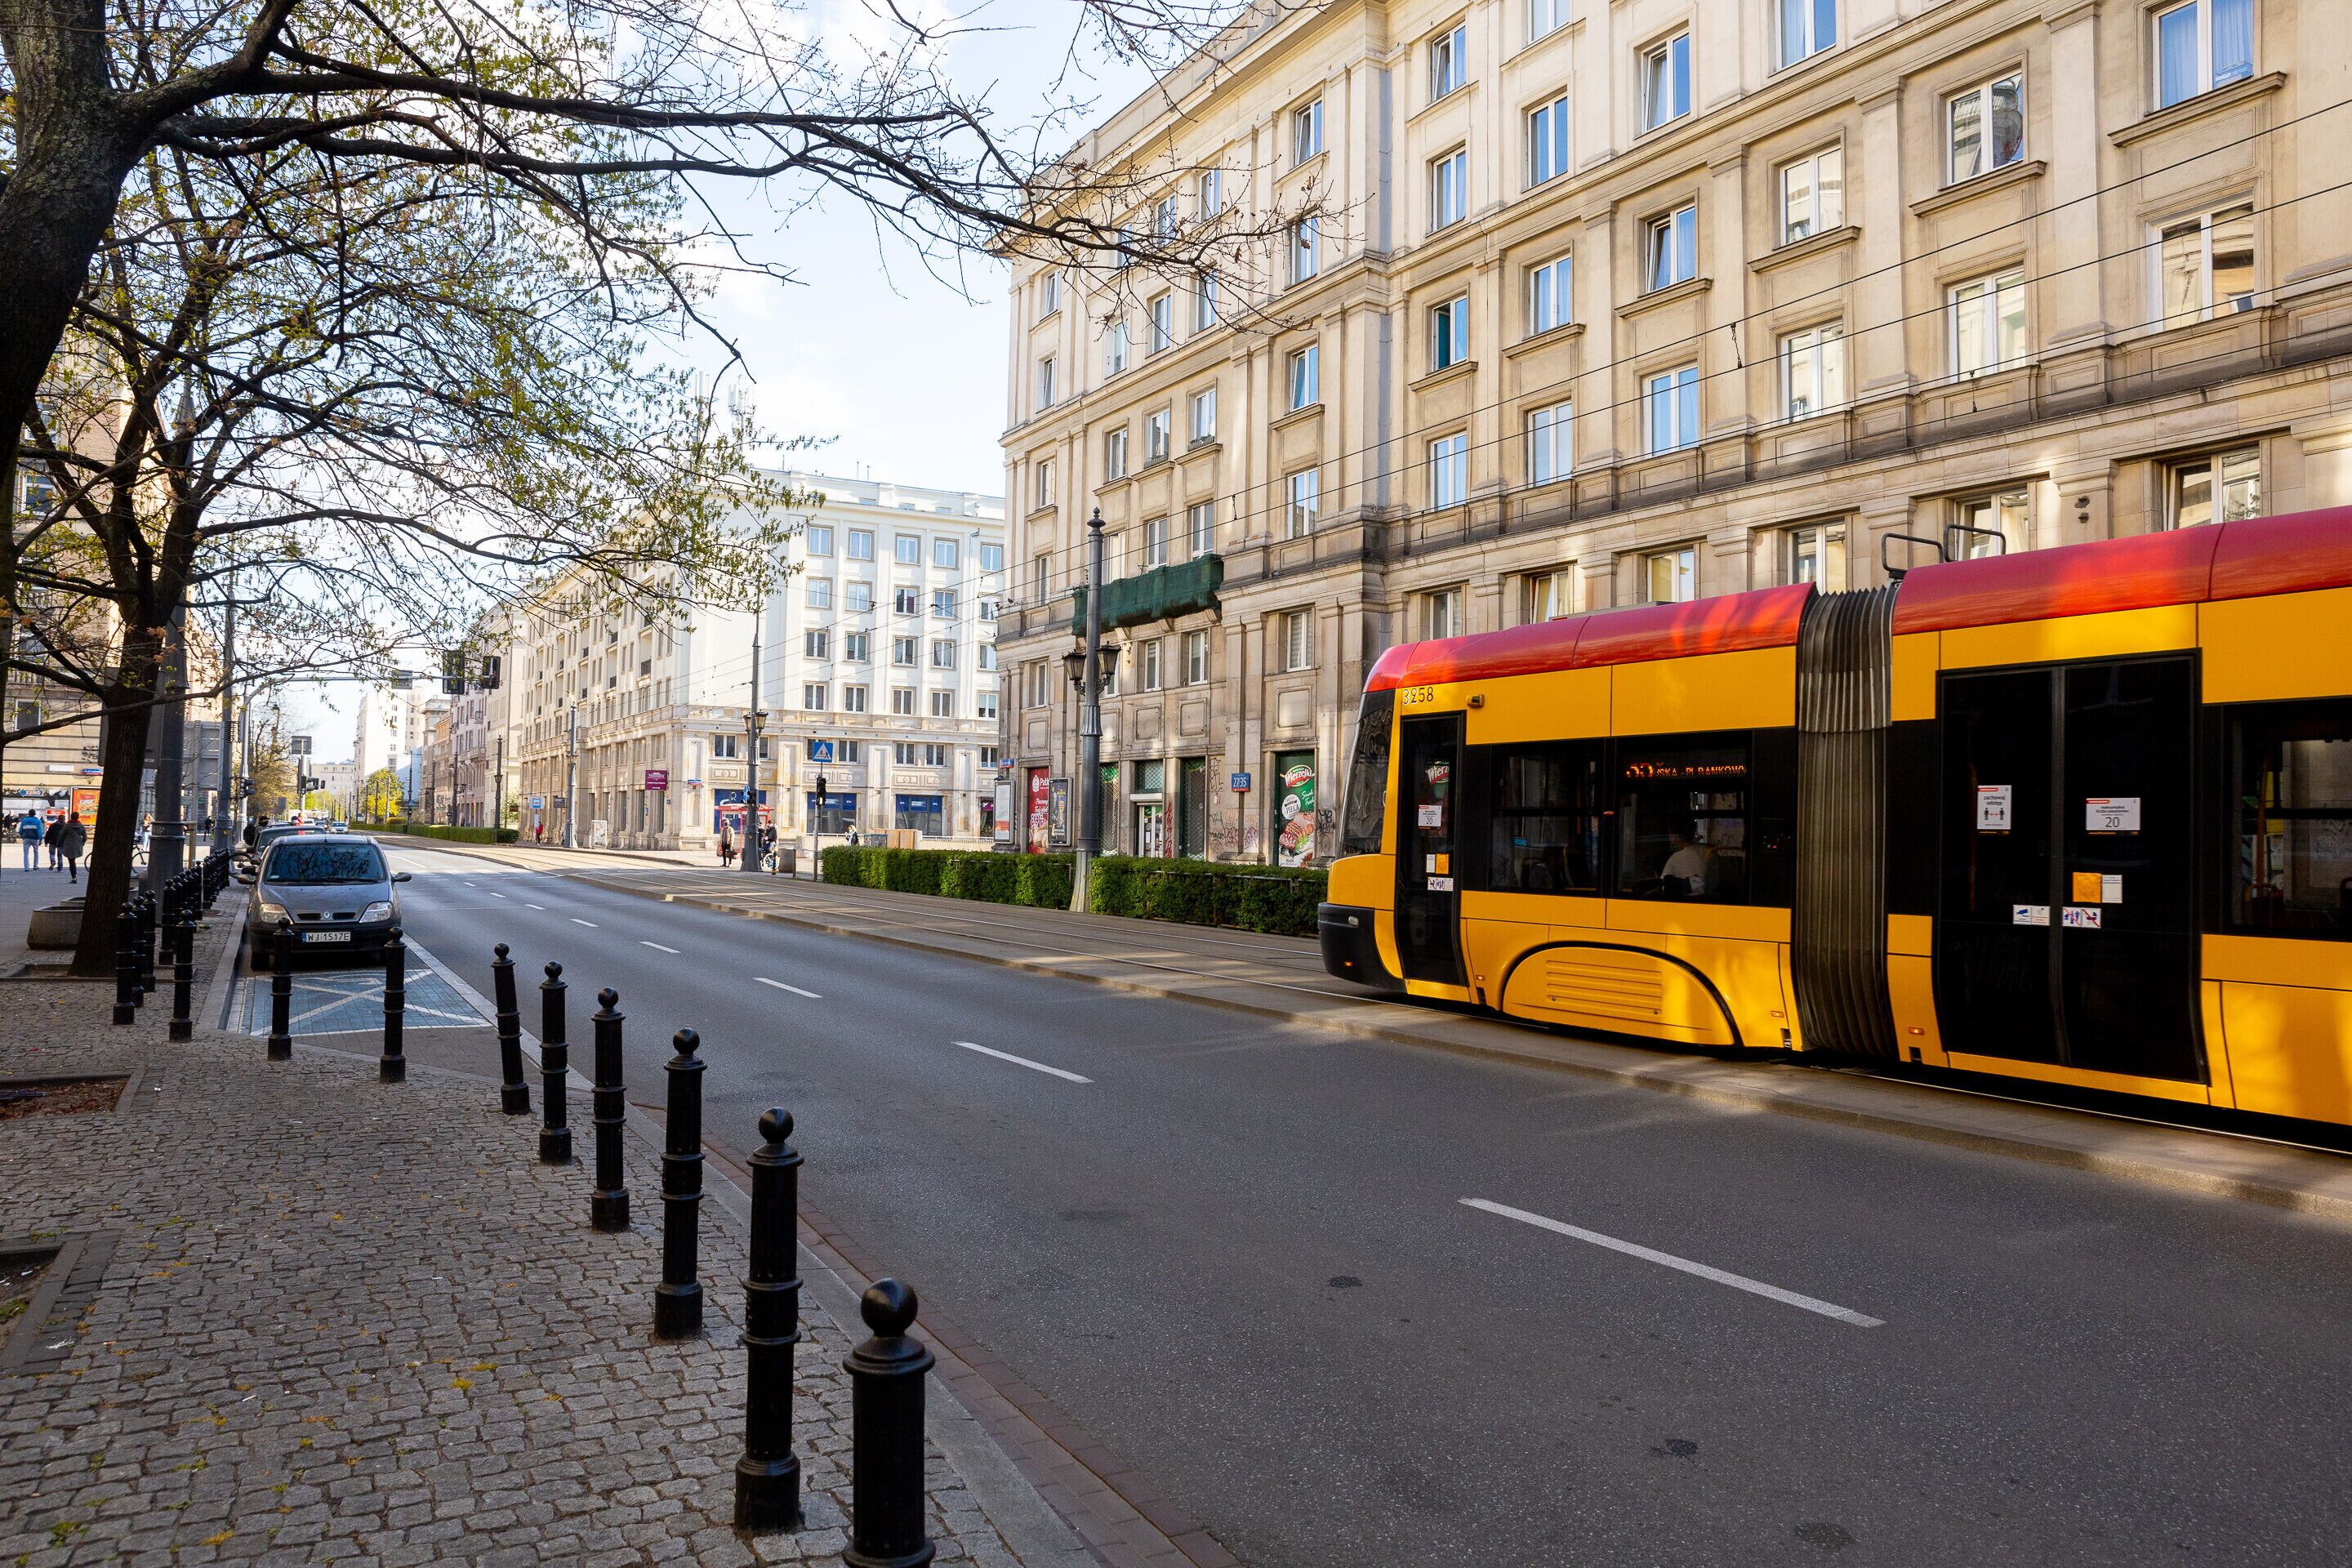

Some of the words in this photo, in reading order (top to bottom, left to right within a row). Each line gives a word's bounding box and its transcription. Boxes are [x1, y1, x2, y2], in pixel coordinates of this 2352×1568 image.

[1402, 687, 1434, 706] 3258
[1284, 768, 1312, 787] Wierzejki
[2105, 817, 2120, 827] 20
[323, 933, 350, 941] 1517E
